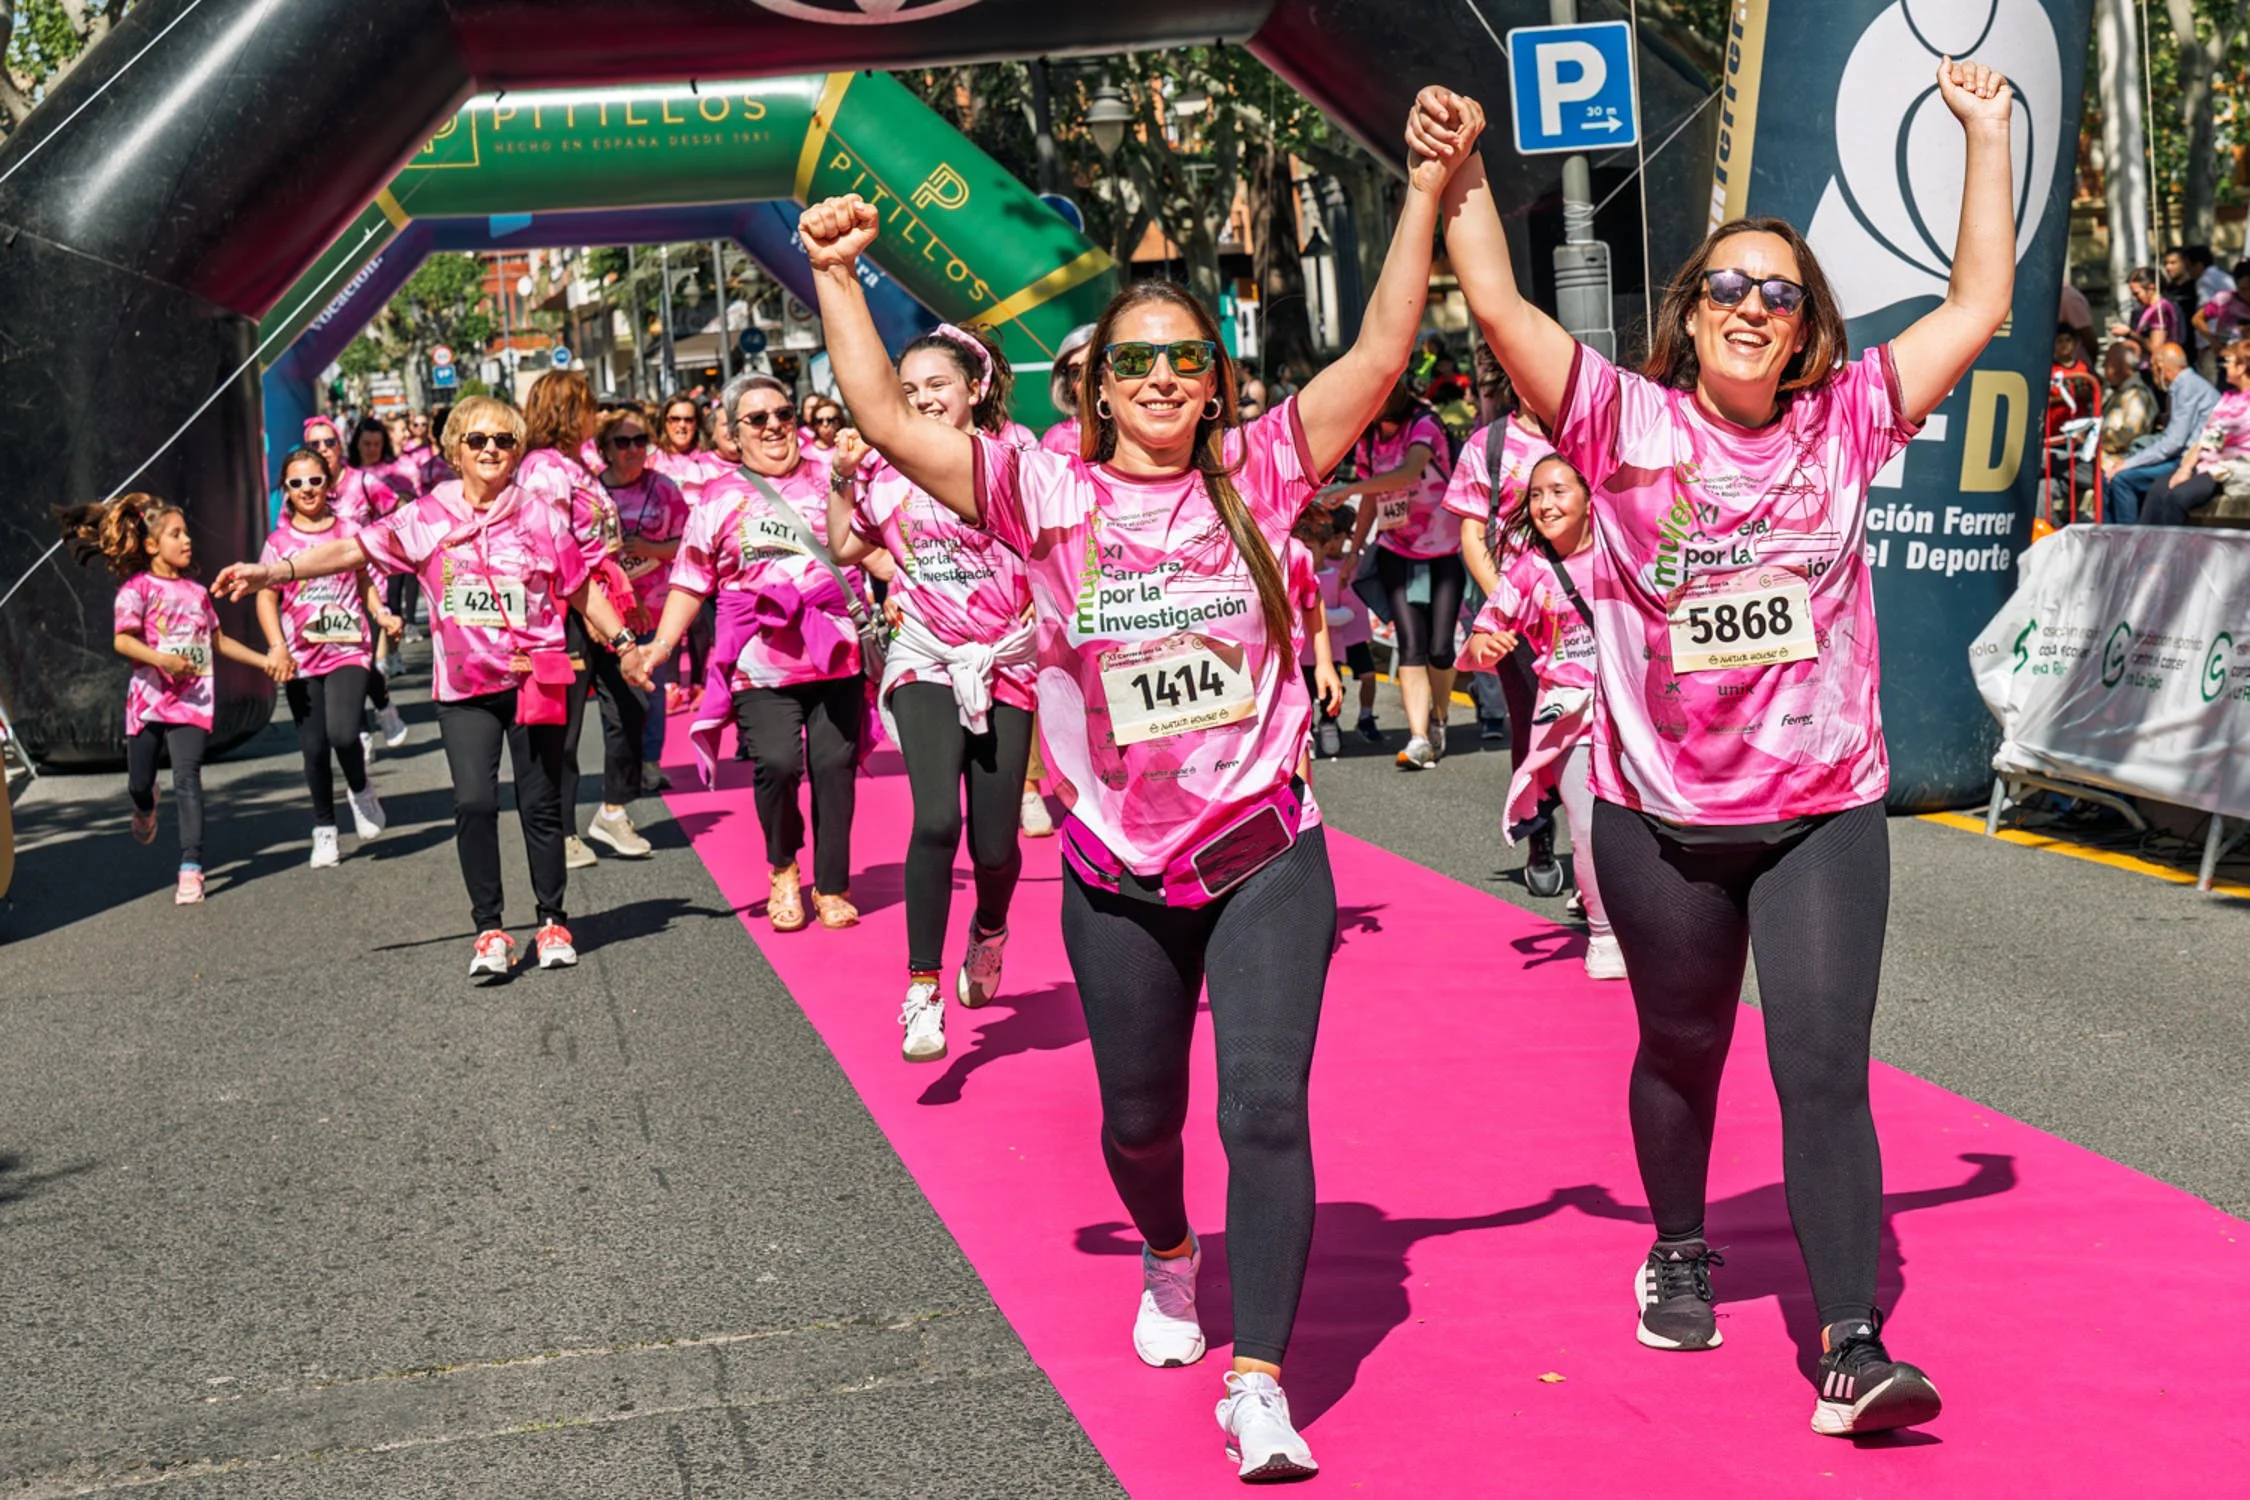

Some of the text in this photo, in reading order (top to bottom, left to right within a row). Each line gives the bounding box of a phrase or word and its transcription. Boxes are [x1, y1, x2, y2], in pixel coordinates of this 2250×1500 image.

[1535, 41, 1607, 136] P
[492, 93, 767, 130] PITILLOS
[1586, 106, 1603, 117] 30
[562, 139, 582, 152] EN
[668, 133, 723, 147] DESDE
[829, 152, 989, 301] PITILLOS
[1697, 503, 1719, 525] XI
[1943, 506, 2015, 535] Ferrer
[1103, 544, 1123, 560] XI
[1655, 496, 1692, 587] mujer
[1684, 544, 1753, 568] por la
[1906, 541, 2011, 577] Deporte
[1100, 582, 1161, 610] por la
[1100, 596, 1248, 632] Investigación
[1688, 596, 1793, 645] 5868
[1566, 646, 1596, 659] Invest
[1131, 660, 1225, 711] 1414
